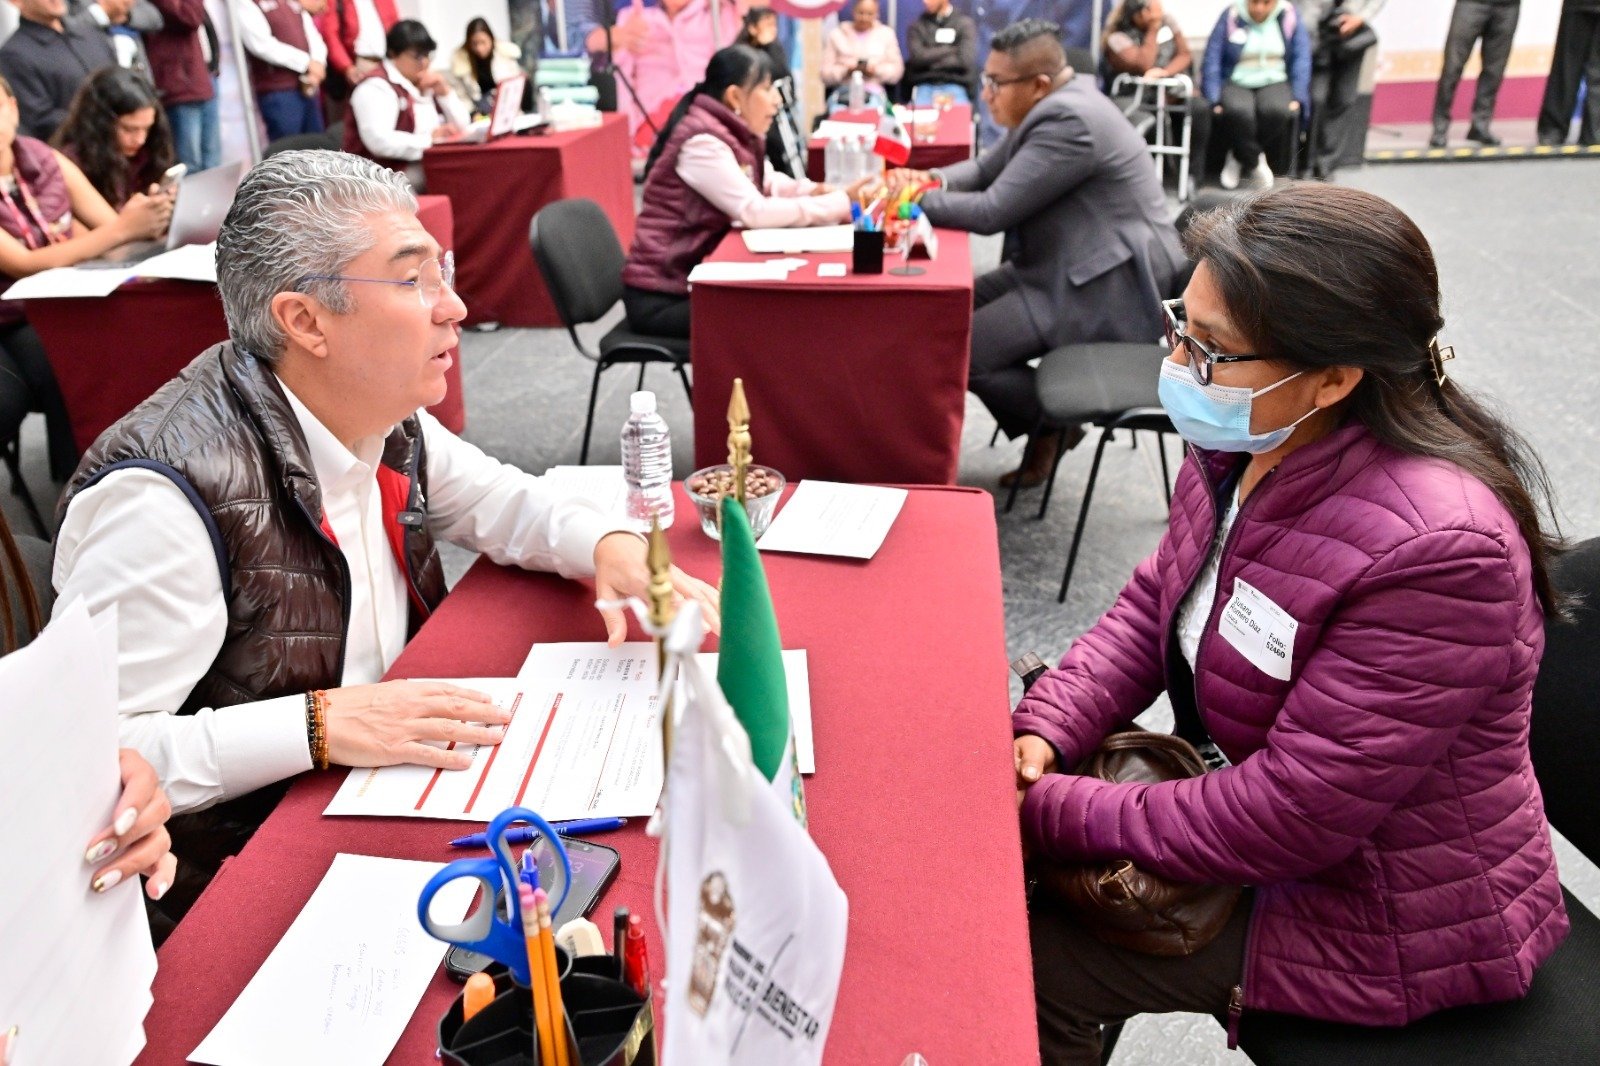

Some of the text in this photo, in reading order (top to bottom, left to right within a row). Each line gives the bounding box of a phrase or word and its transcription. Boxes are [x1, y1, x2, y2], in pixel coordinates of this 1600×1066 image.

[1230, 603, 1249, 624] Romero
[1233, 596, 1252, 616] Susana
[1268, 633, 1286, 650] Folio:
[762, 981, 820, 1040] BIENESTAR
